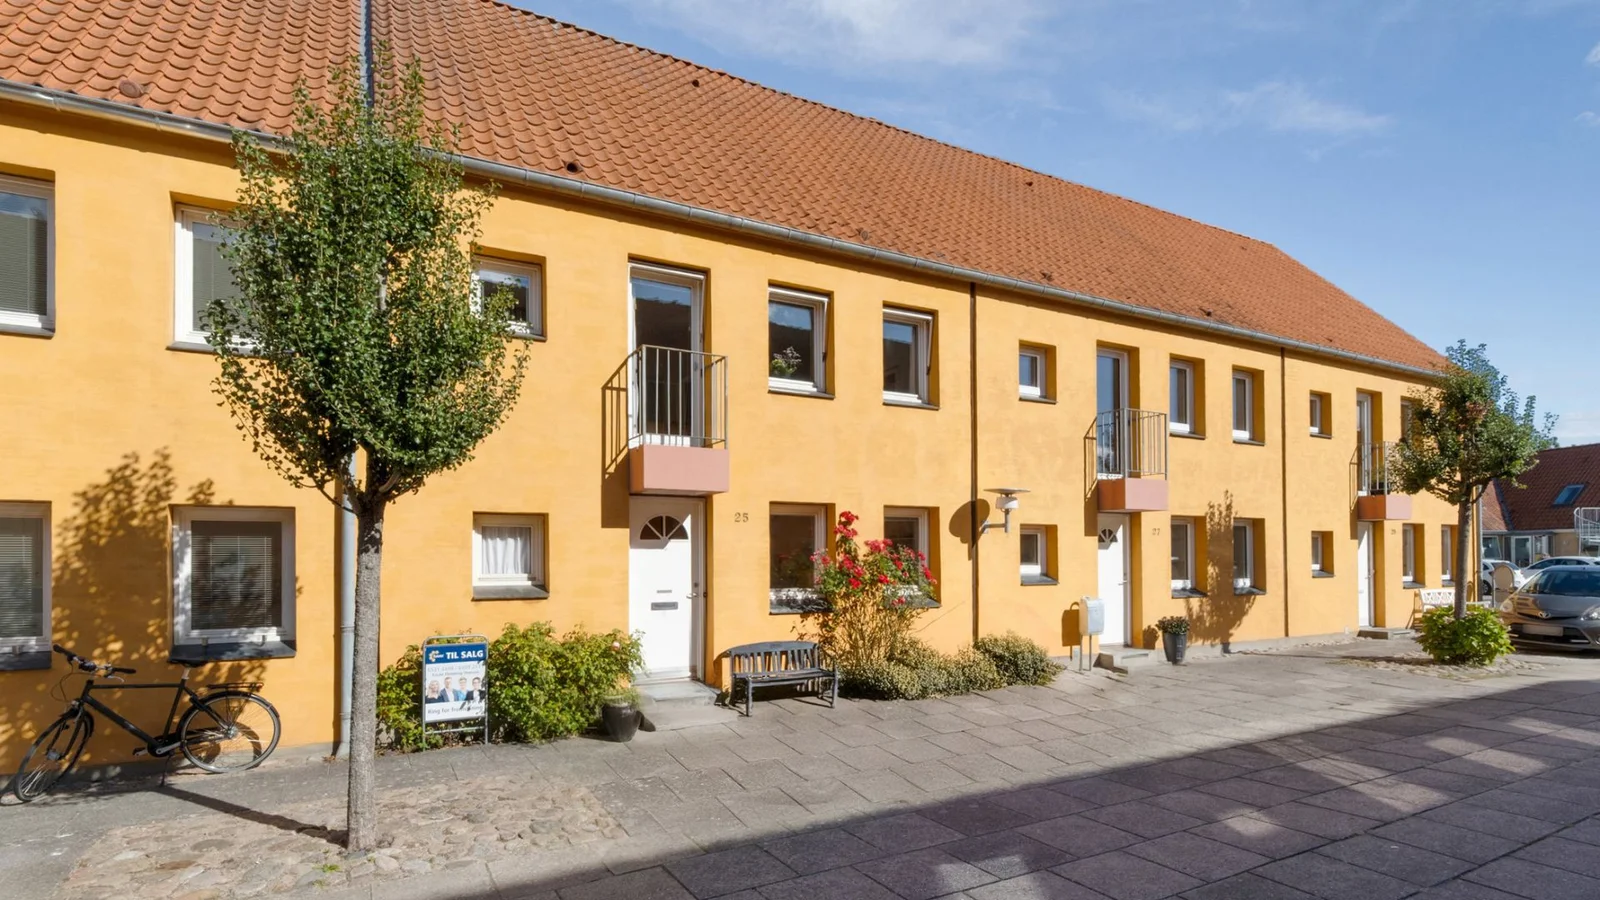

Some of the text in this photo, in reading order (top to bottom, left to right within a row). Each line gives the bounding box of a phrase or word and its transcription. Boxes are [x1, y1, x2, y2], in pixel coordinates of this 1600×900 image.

[734, 512, 749, 523] 25
[446, 651, 459, 659] TIL
[461, 650, 484, 659] SALG
